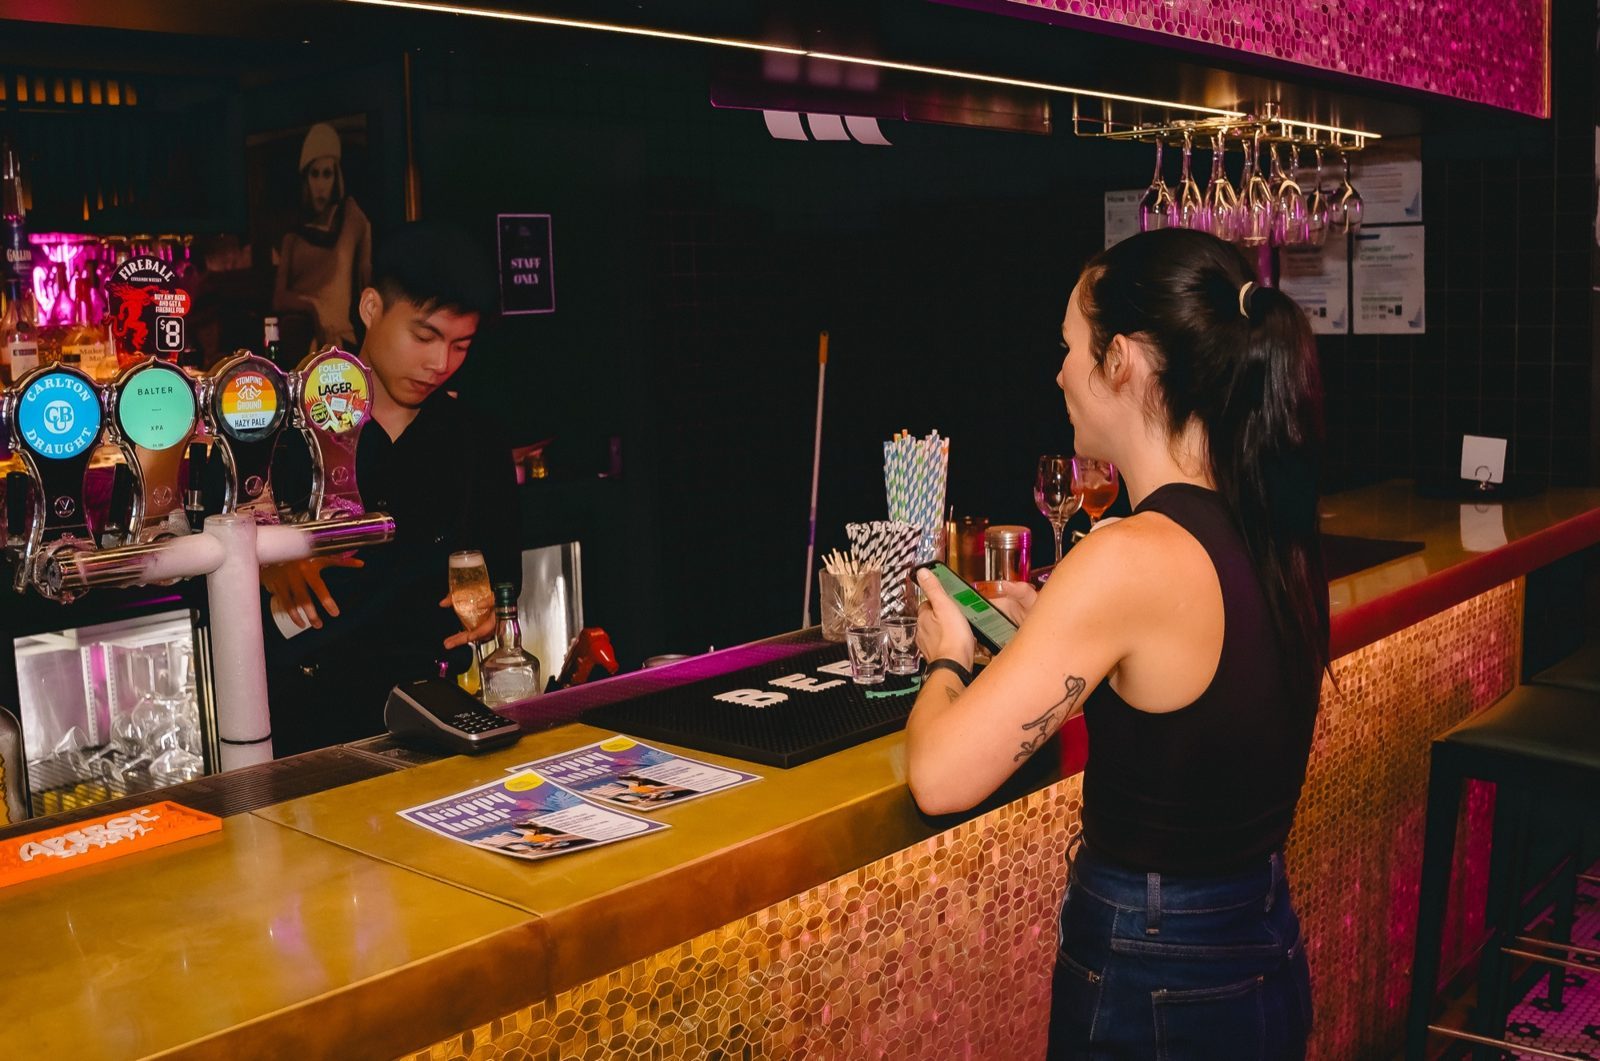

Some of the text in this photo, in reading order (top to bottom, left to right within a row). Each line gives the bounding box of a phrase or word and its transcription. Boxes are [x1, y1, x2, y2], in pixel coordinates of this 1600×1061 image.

[511, 258, 541, 269] STAFF
[118, 259, 174, 282] FIREBALL
[513, 273, 539, 284] ONLY
[318, 362, 351, 373] FOLLIES
[320, 372, 345, 384] GIRL
[26, 377, 92, 402] CARLTON
[137, 386, 174, 396] BALTER
[318, 382, 352, 396] LAGER
[234, 417, 266, 428] HAZY PALE
[25, 426, 92, 454] DRAUGHT
[414, 791, 517, 823] happy
[436, 808, 511, 833] hour
